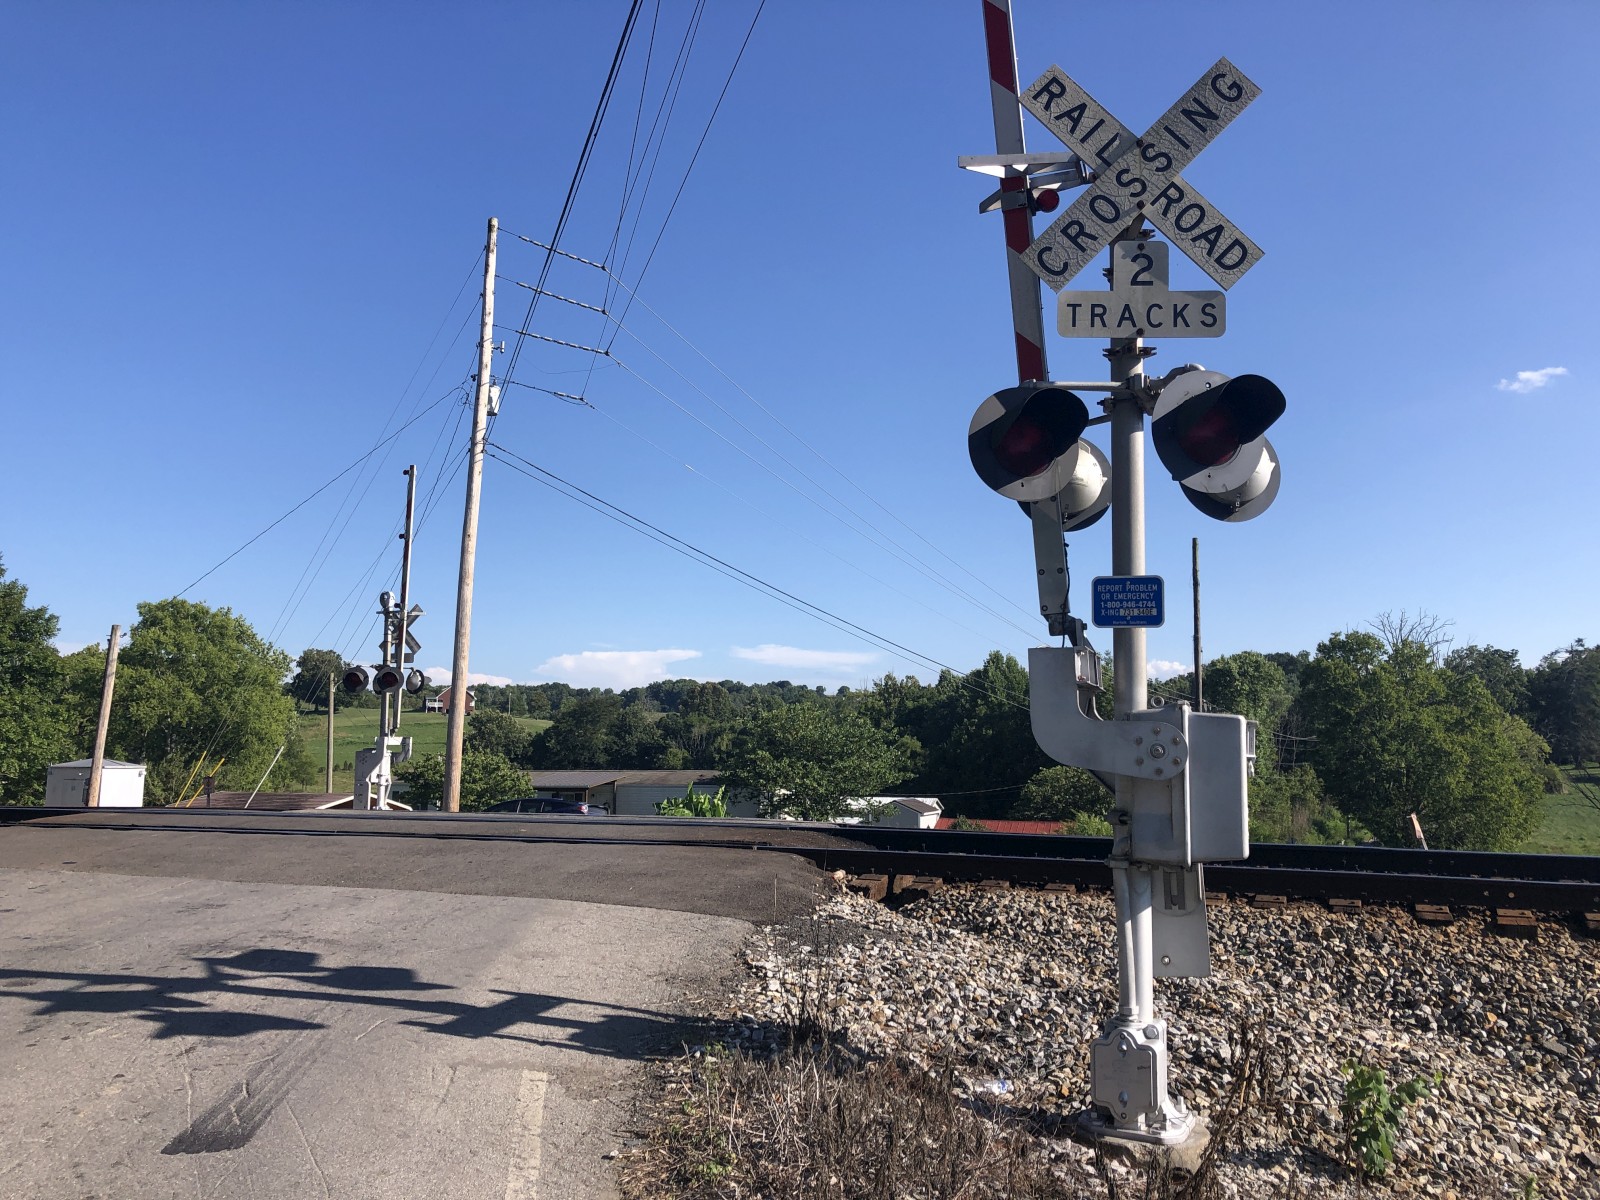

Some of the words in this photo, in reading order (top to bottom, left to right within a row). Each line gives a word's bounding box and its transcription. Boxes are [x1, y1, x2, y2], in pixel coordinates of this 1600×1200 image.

[1032, 76, 1121, 168] RAIL
[1150, 181, 1248, 271] ROAD
[1036, 73, 1243, 277] CROSSING
[1130, 253, 1154, 286] 2
[1066, 303, 1218, 329] TRACKS
[1100, 600, 1156, 608] 1-800-946-4744
[1113, 592, 1154, 600] EMERGENCY
[1101, 608, 1119, 616] X-ING
